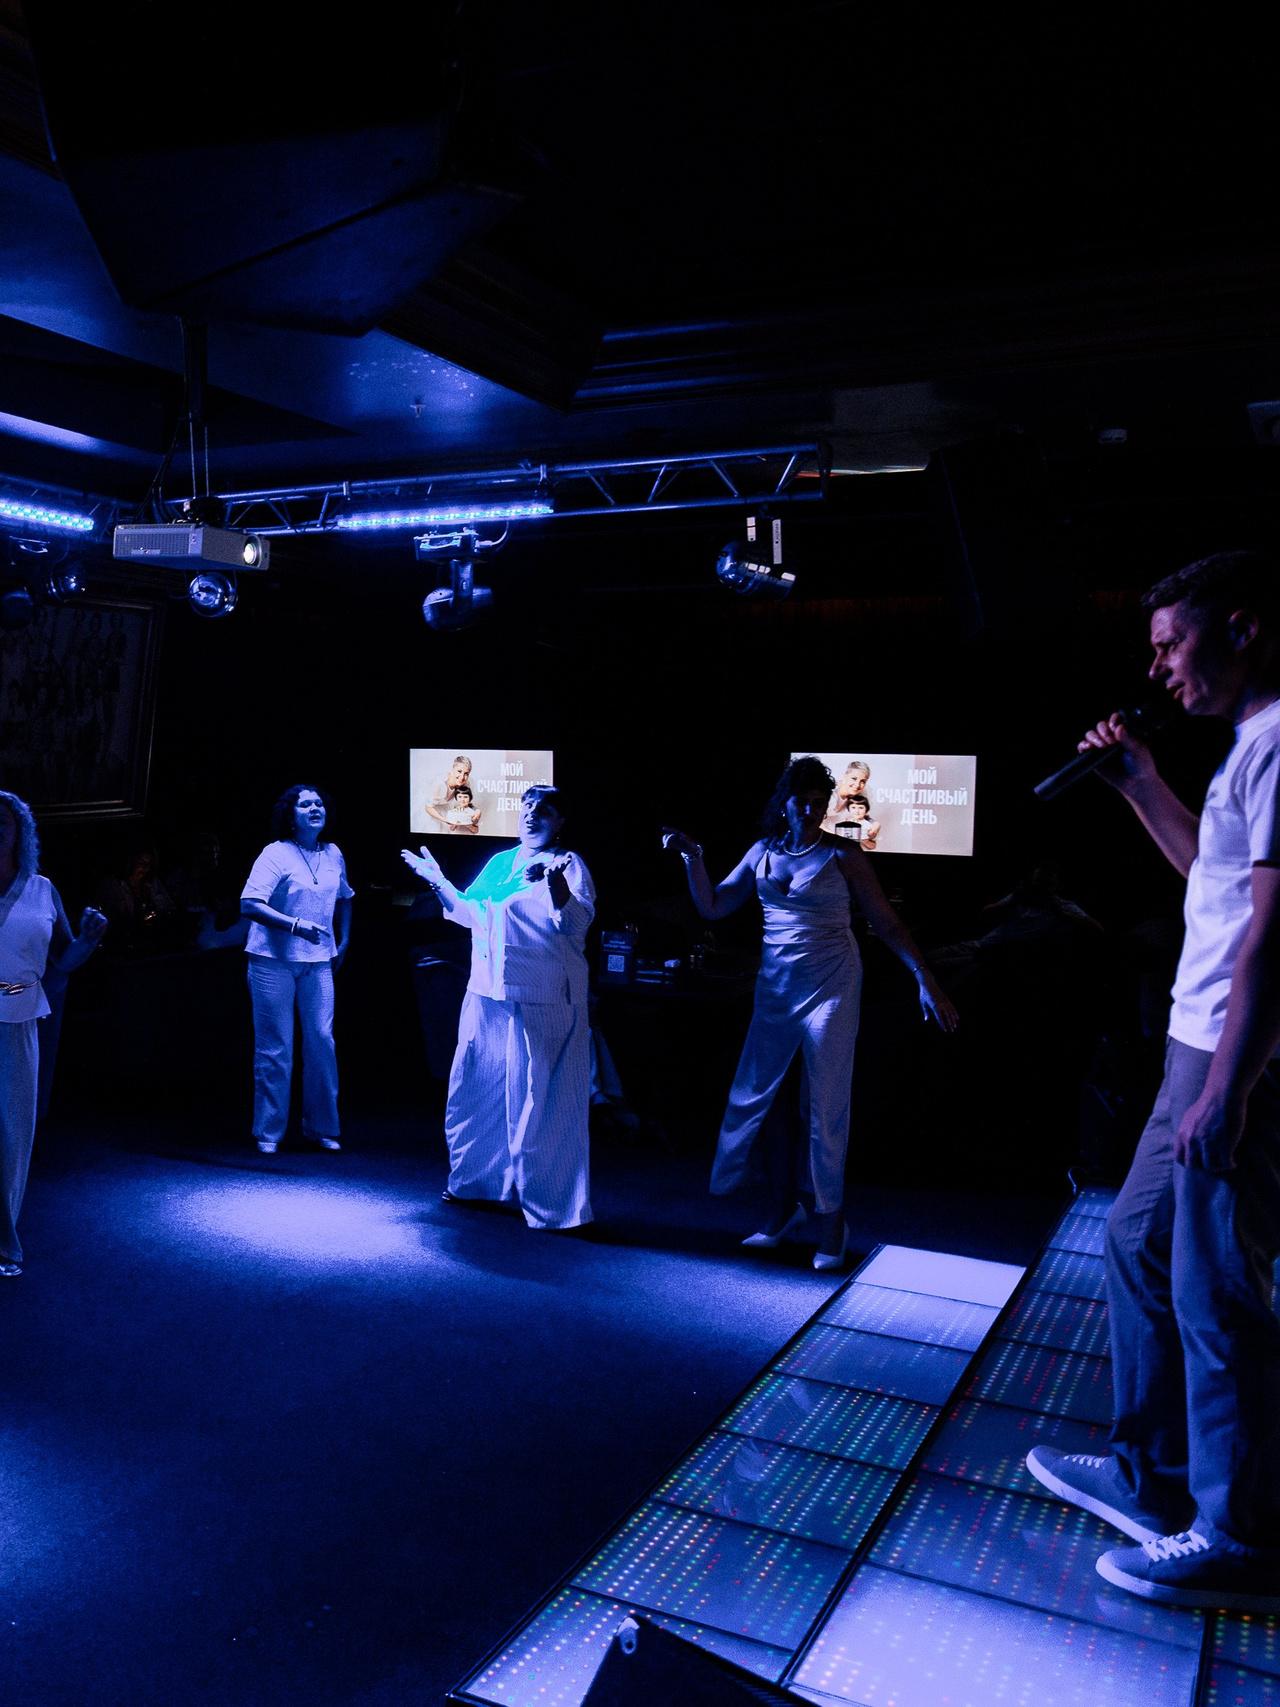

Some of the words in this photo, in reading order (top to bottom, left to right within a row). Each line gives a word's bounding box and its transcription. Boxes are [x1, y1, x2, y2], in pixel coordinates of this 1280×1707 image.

[500, 761, 524, 777] МОЙ
[907, 766, 937, 785] МОЙ
[876, 787, 968, 806] СЧАСТЛИВЫЙ
[900, 808, 937, 825] ДЕНЬ
